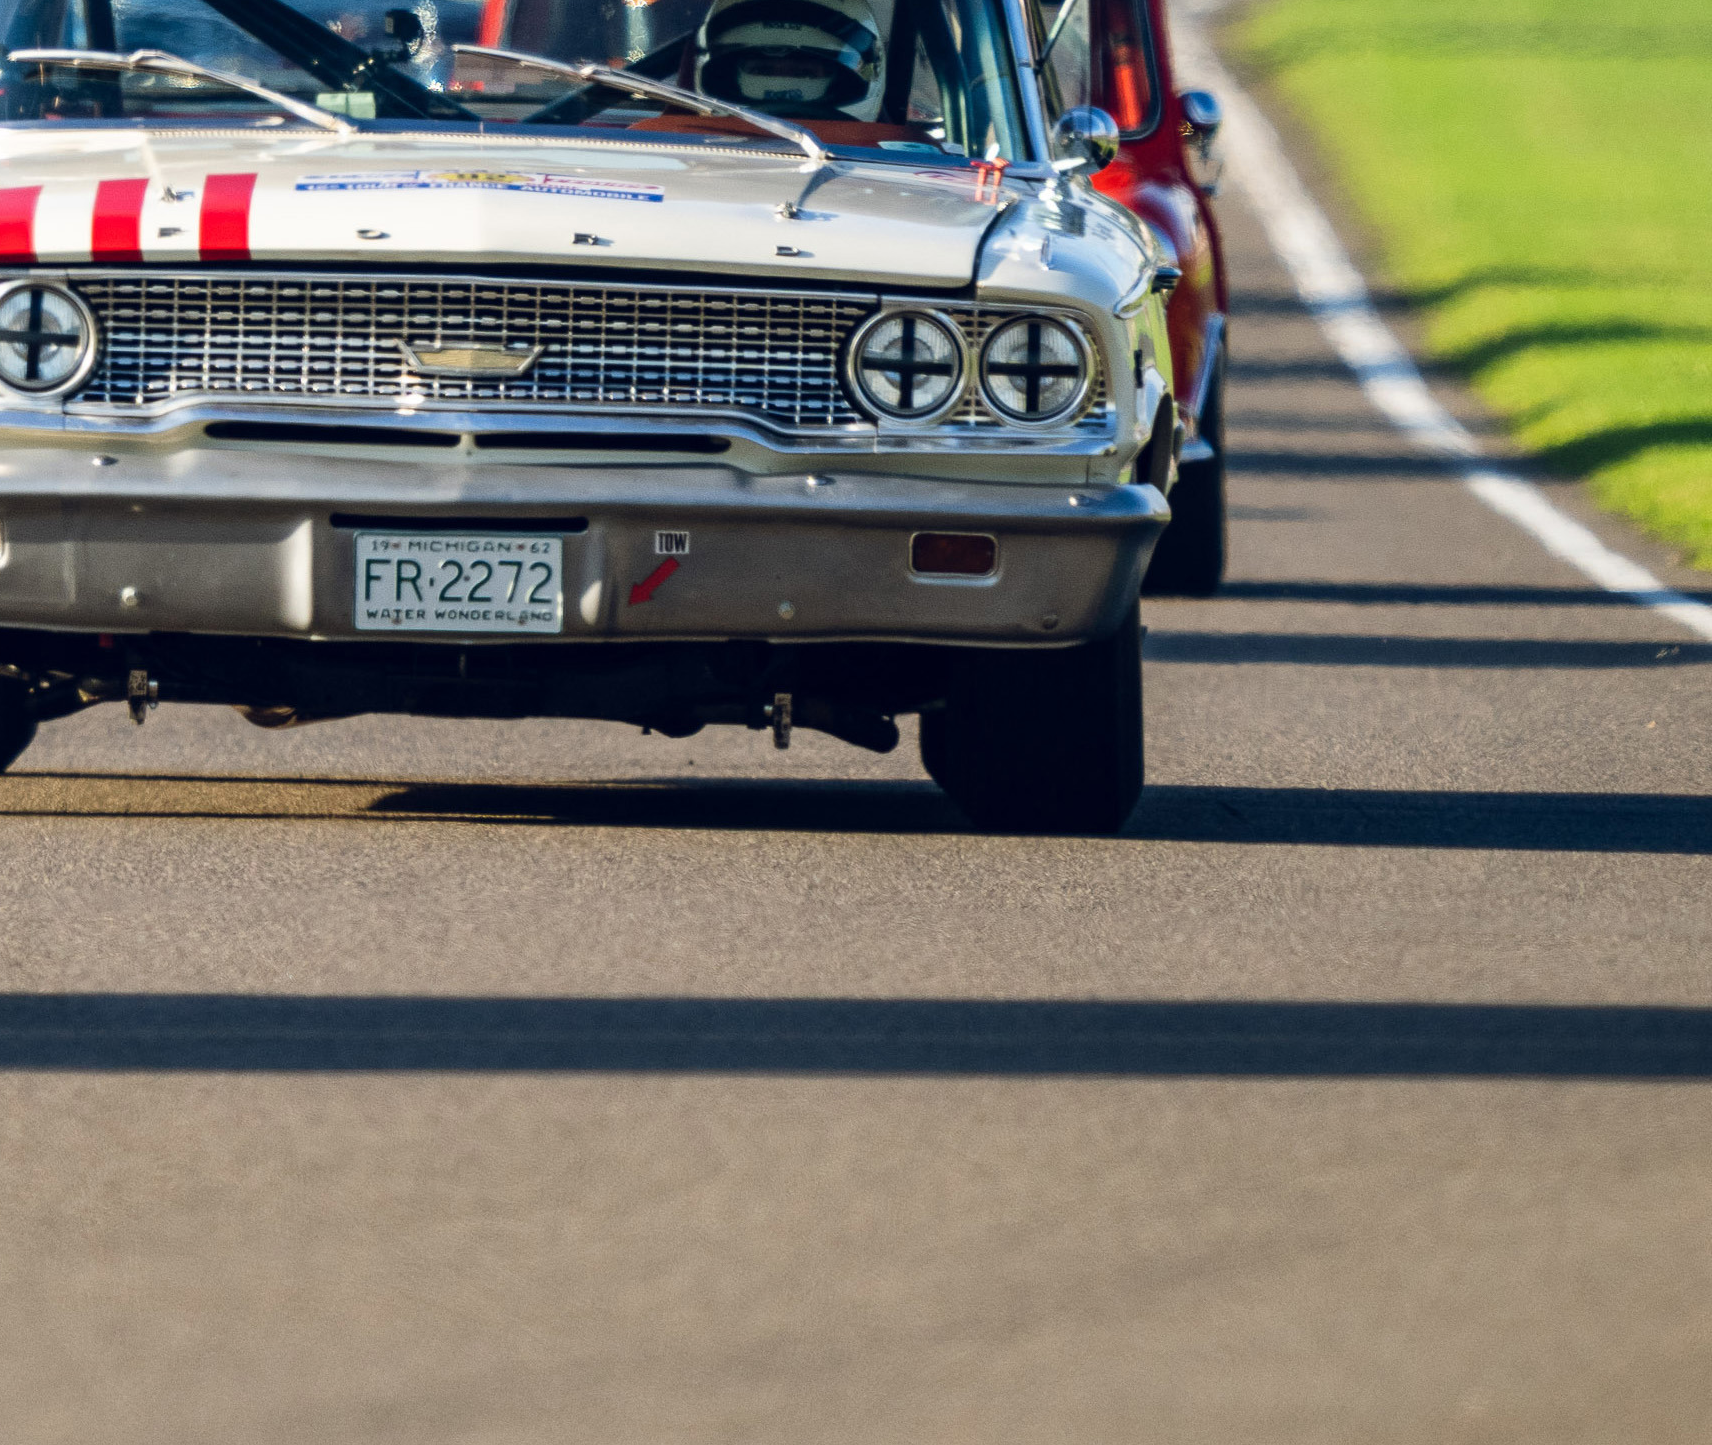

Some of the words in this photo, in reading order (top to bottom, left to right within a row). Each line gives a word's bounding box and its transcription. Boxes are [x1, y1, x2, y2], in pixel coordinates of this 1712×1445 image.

[429, 180, 507, 190] FRANCE
[520, 184, 650, 201] AUTOMOBILE
[372, 540, 390, 551] 19
[408, 541, 512, 553] MICHIGAN
[529, 542, 551, 554] 62
[657, 533, 688, 553] TOW
[366, 609, 426, 621] WATER
[434, 609, 554, 622] WONDERLAND
